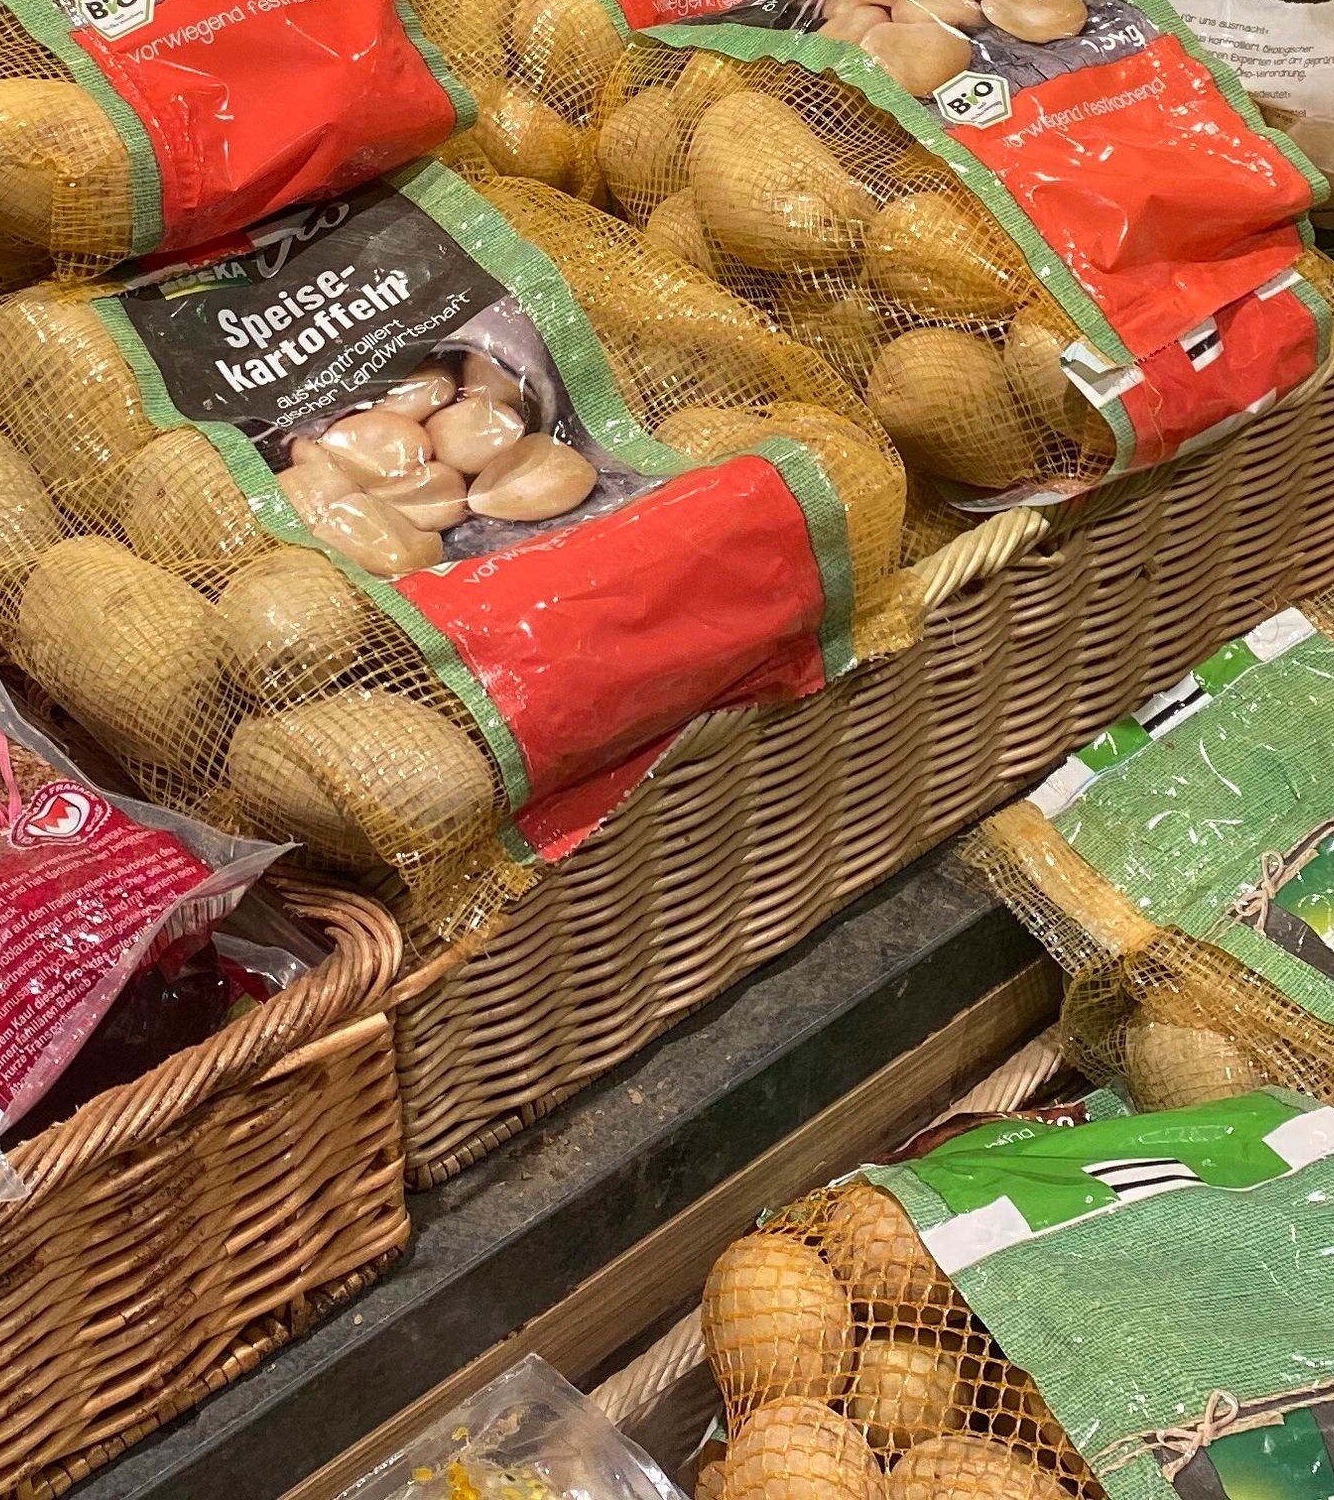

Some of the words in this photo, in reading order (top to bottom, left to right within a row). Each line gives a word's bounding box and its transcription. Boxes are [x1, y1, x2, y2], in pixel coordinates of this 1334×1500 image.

[129, 4, 244, 65] vorwiegend
[1083, 77, 1166, 120] festkochend
[215, 269, 412, 393] kartoffeln
[217, 265, 357, 349] Speise-
[340, 294, 471, 393] Landwirtschaft
[277, 387, 309, 410] aus
[307, 318, 406, 393] kontrolliert
[12, 1001, 37, 1032] Kauf
